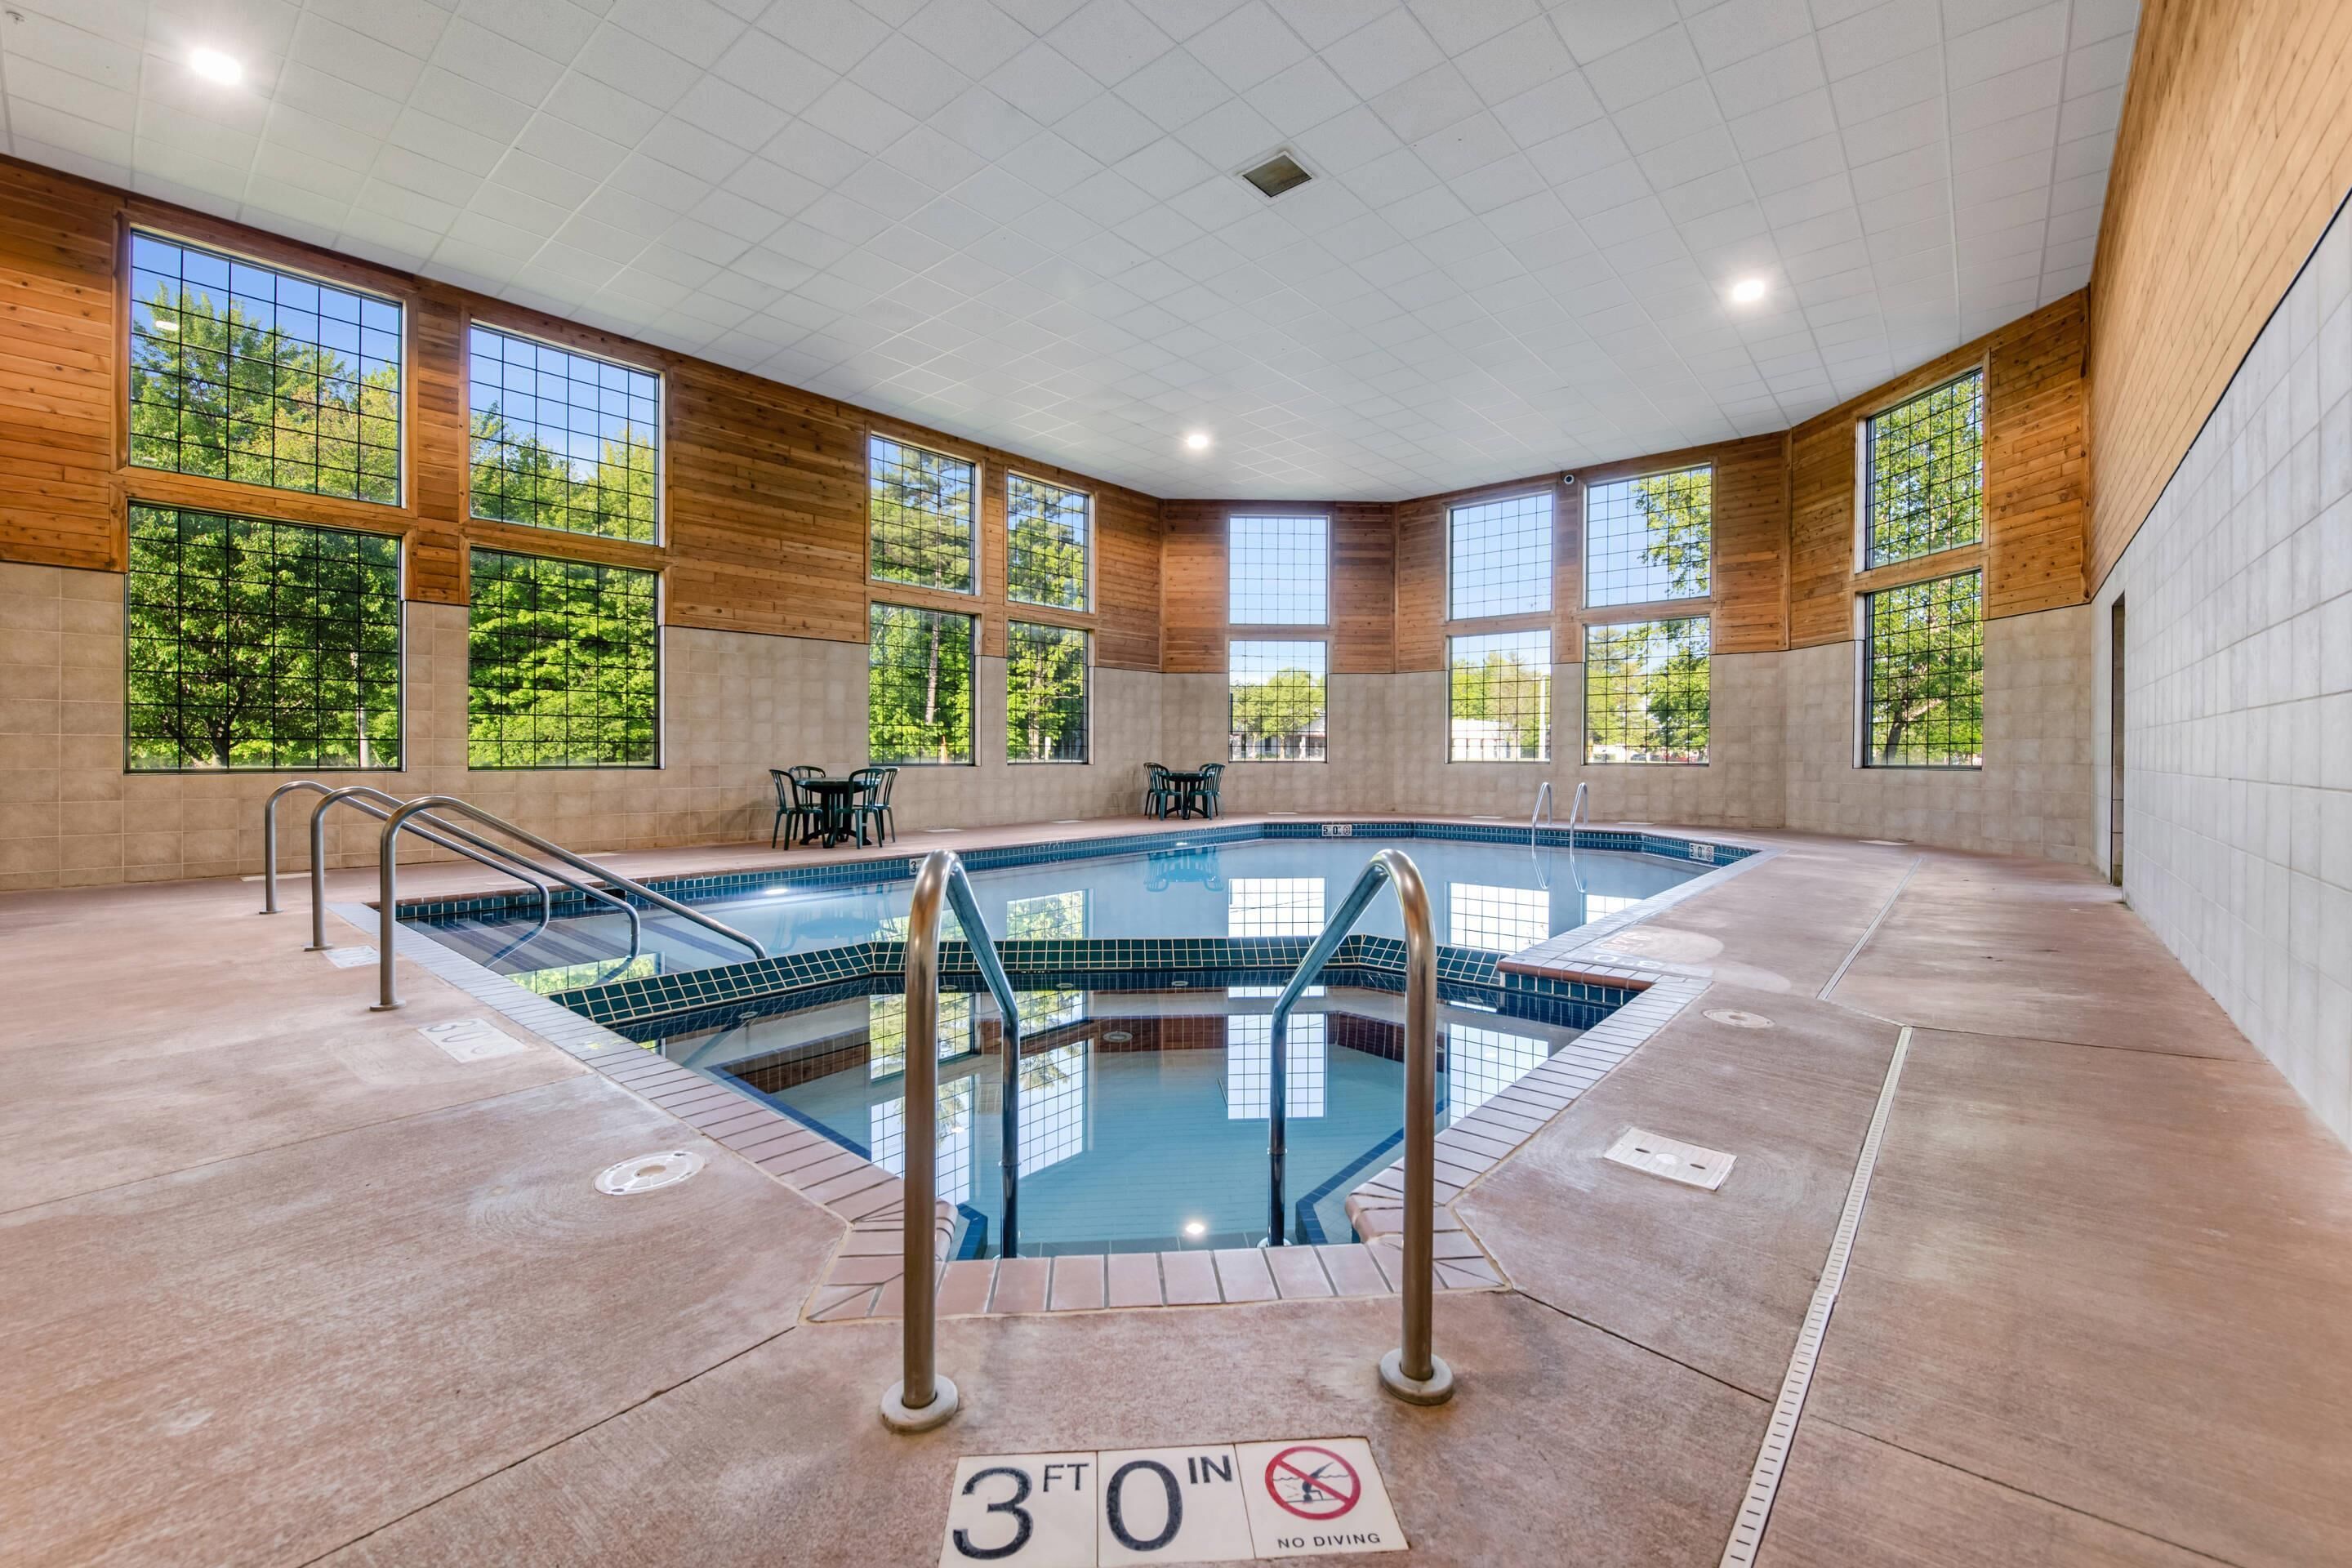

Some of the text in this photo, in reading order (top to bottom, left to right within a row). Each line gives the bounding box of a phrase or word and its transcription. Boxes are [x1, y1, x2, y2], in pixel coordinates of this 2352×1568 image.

[1323, 826, 1328, 835] 5
[1333, 826, 1339, 835] 0
[911, 861, 916, 873] 3
[952, 1455, 1232, 1561] 3 FT 0 IN
[1276, 1533, 1381, 1549] NO DIVING
